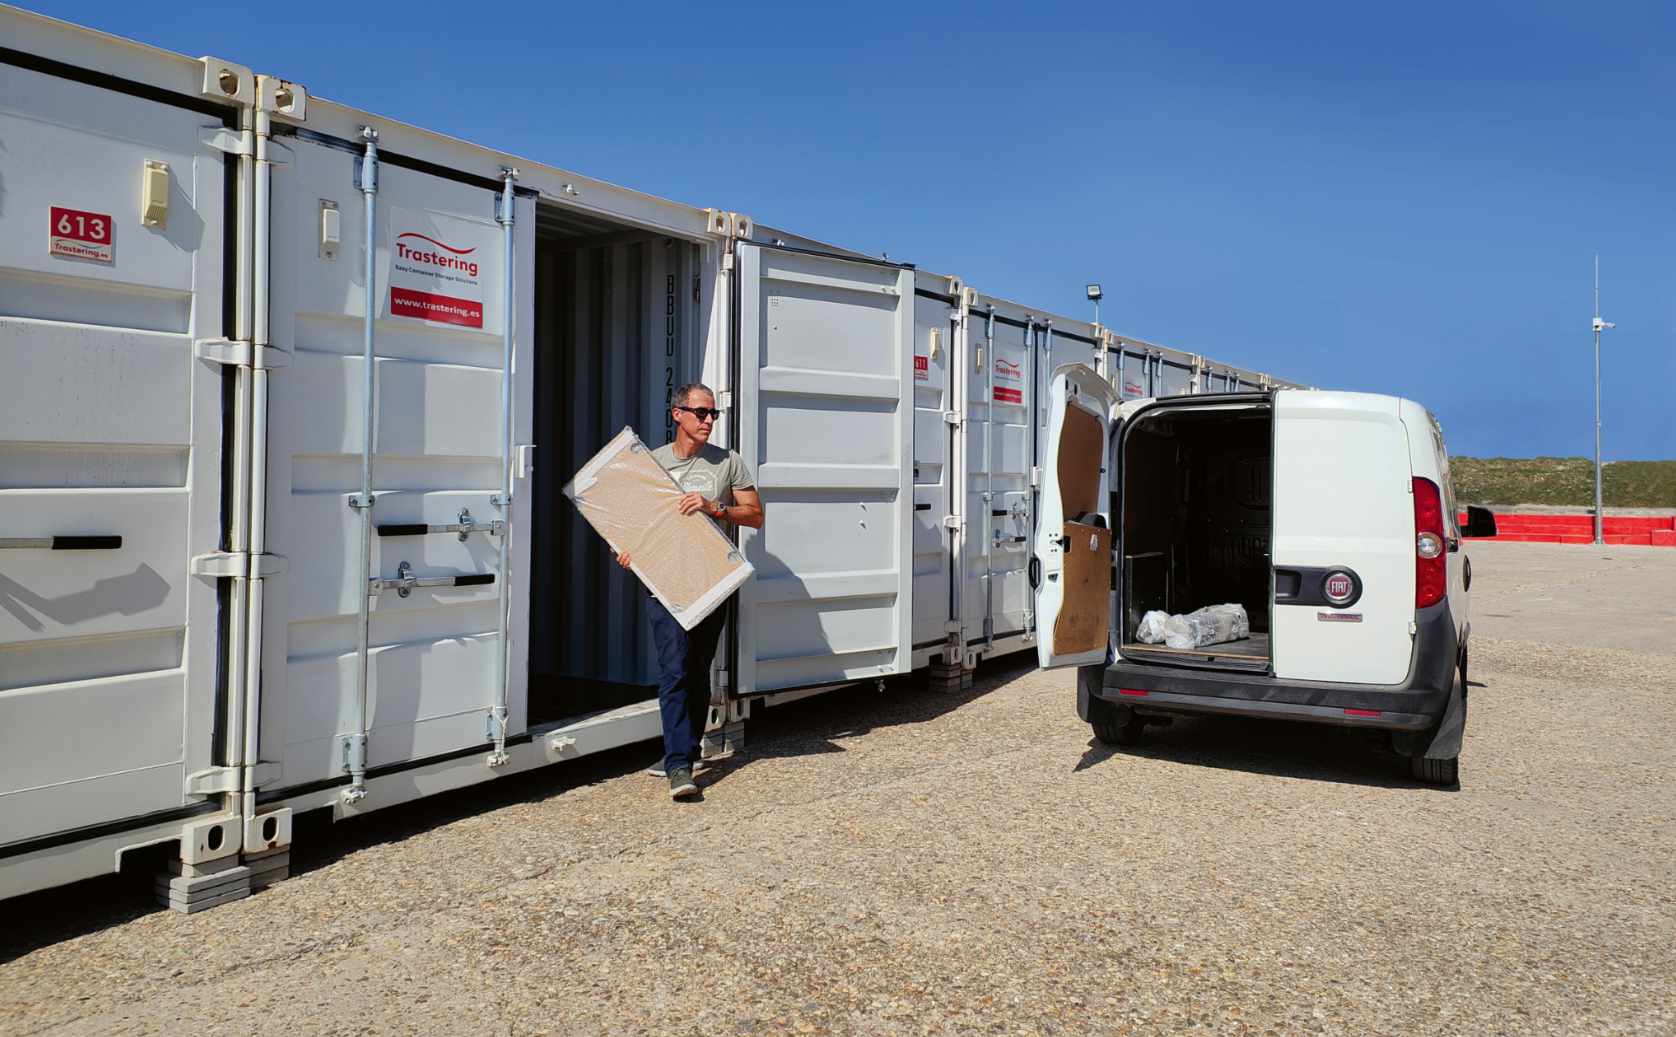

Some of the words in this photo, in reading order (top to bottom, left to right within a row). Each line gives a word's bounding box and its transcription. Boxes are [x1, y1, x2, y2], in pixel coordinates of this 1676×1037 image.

[57, 213, 105, 240] 613
[396, 242, 478, 277] Trastering
[394, 297, 481, 318] www.trastering.es
[666, 274, 674, 357] BBUU
[1331, 581, 1349, 593] FIAT
